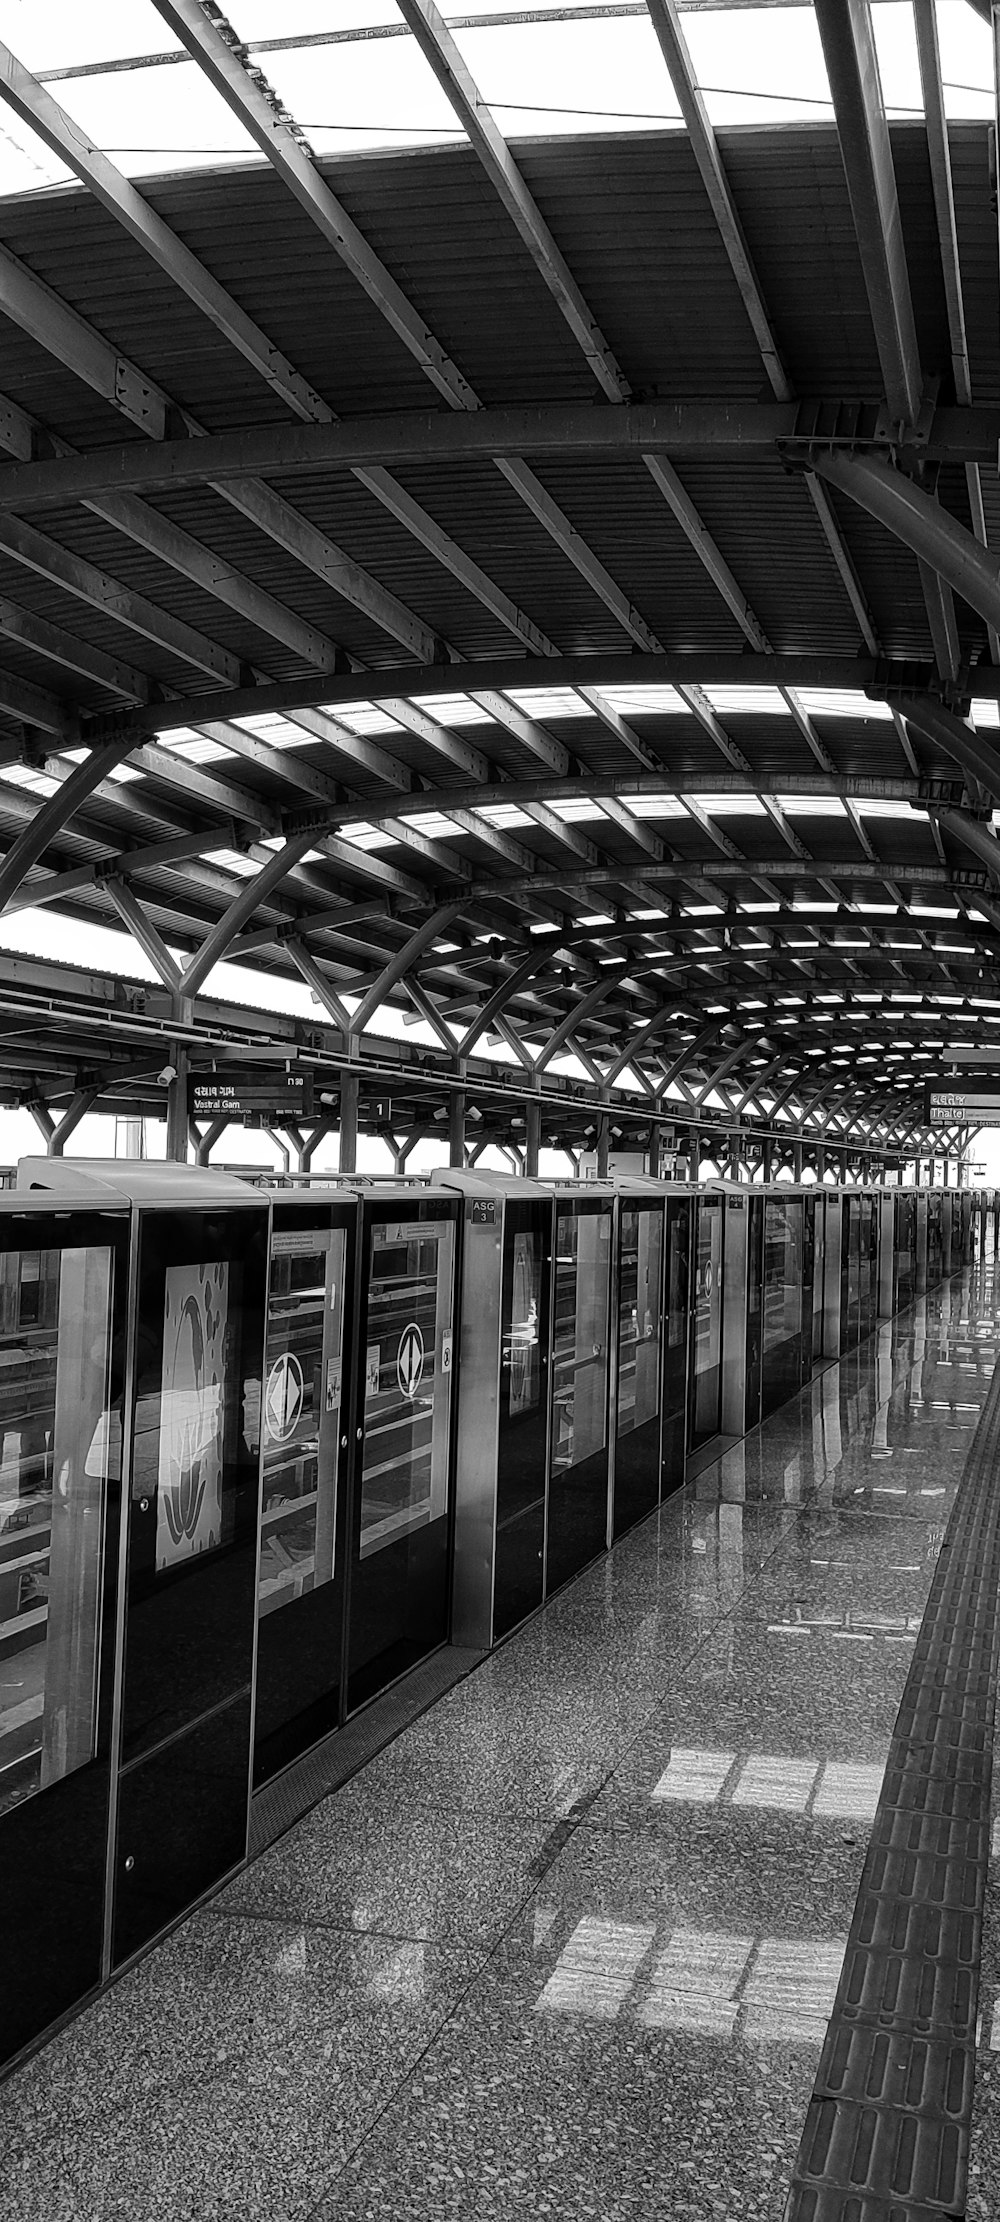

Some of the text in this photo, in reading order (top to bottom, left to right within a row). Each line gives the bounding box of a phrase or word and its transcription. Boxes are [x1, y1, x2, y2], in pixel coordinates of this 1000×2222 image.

[221, 1099, 240, 1109] Gam
[376, 1103, 383, 1115] 1
[931, 1107, 966, 1121] Thaltej
[473, 1202, 495, 1211] ASG
[480, 1212, 487, 1222] 3
